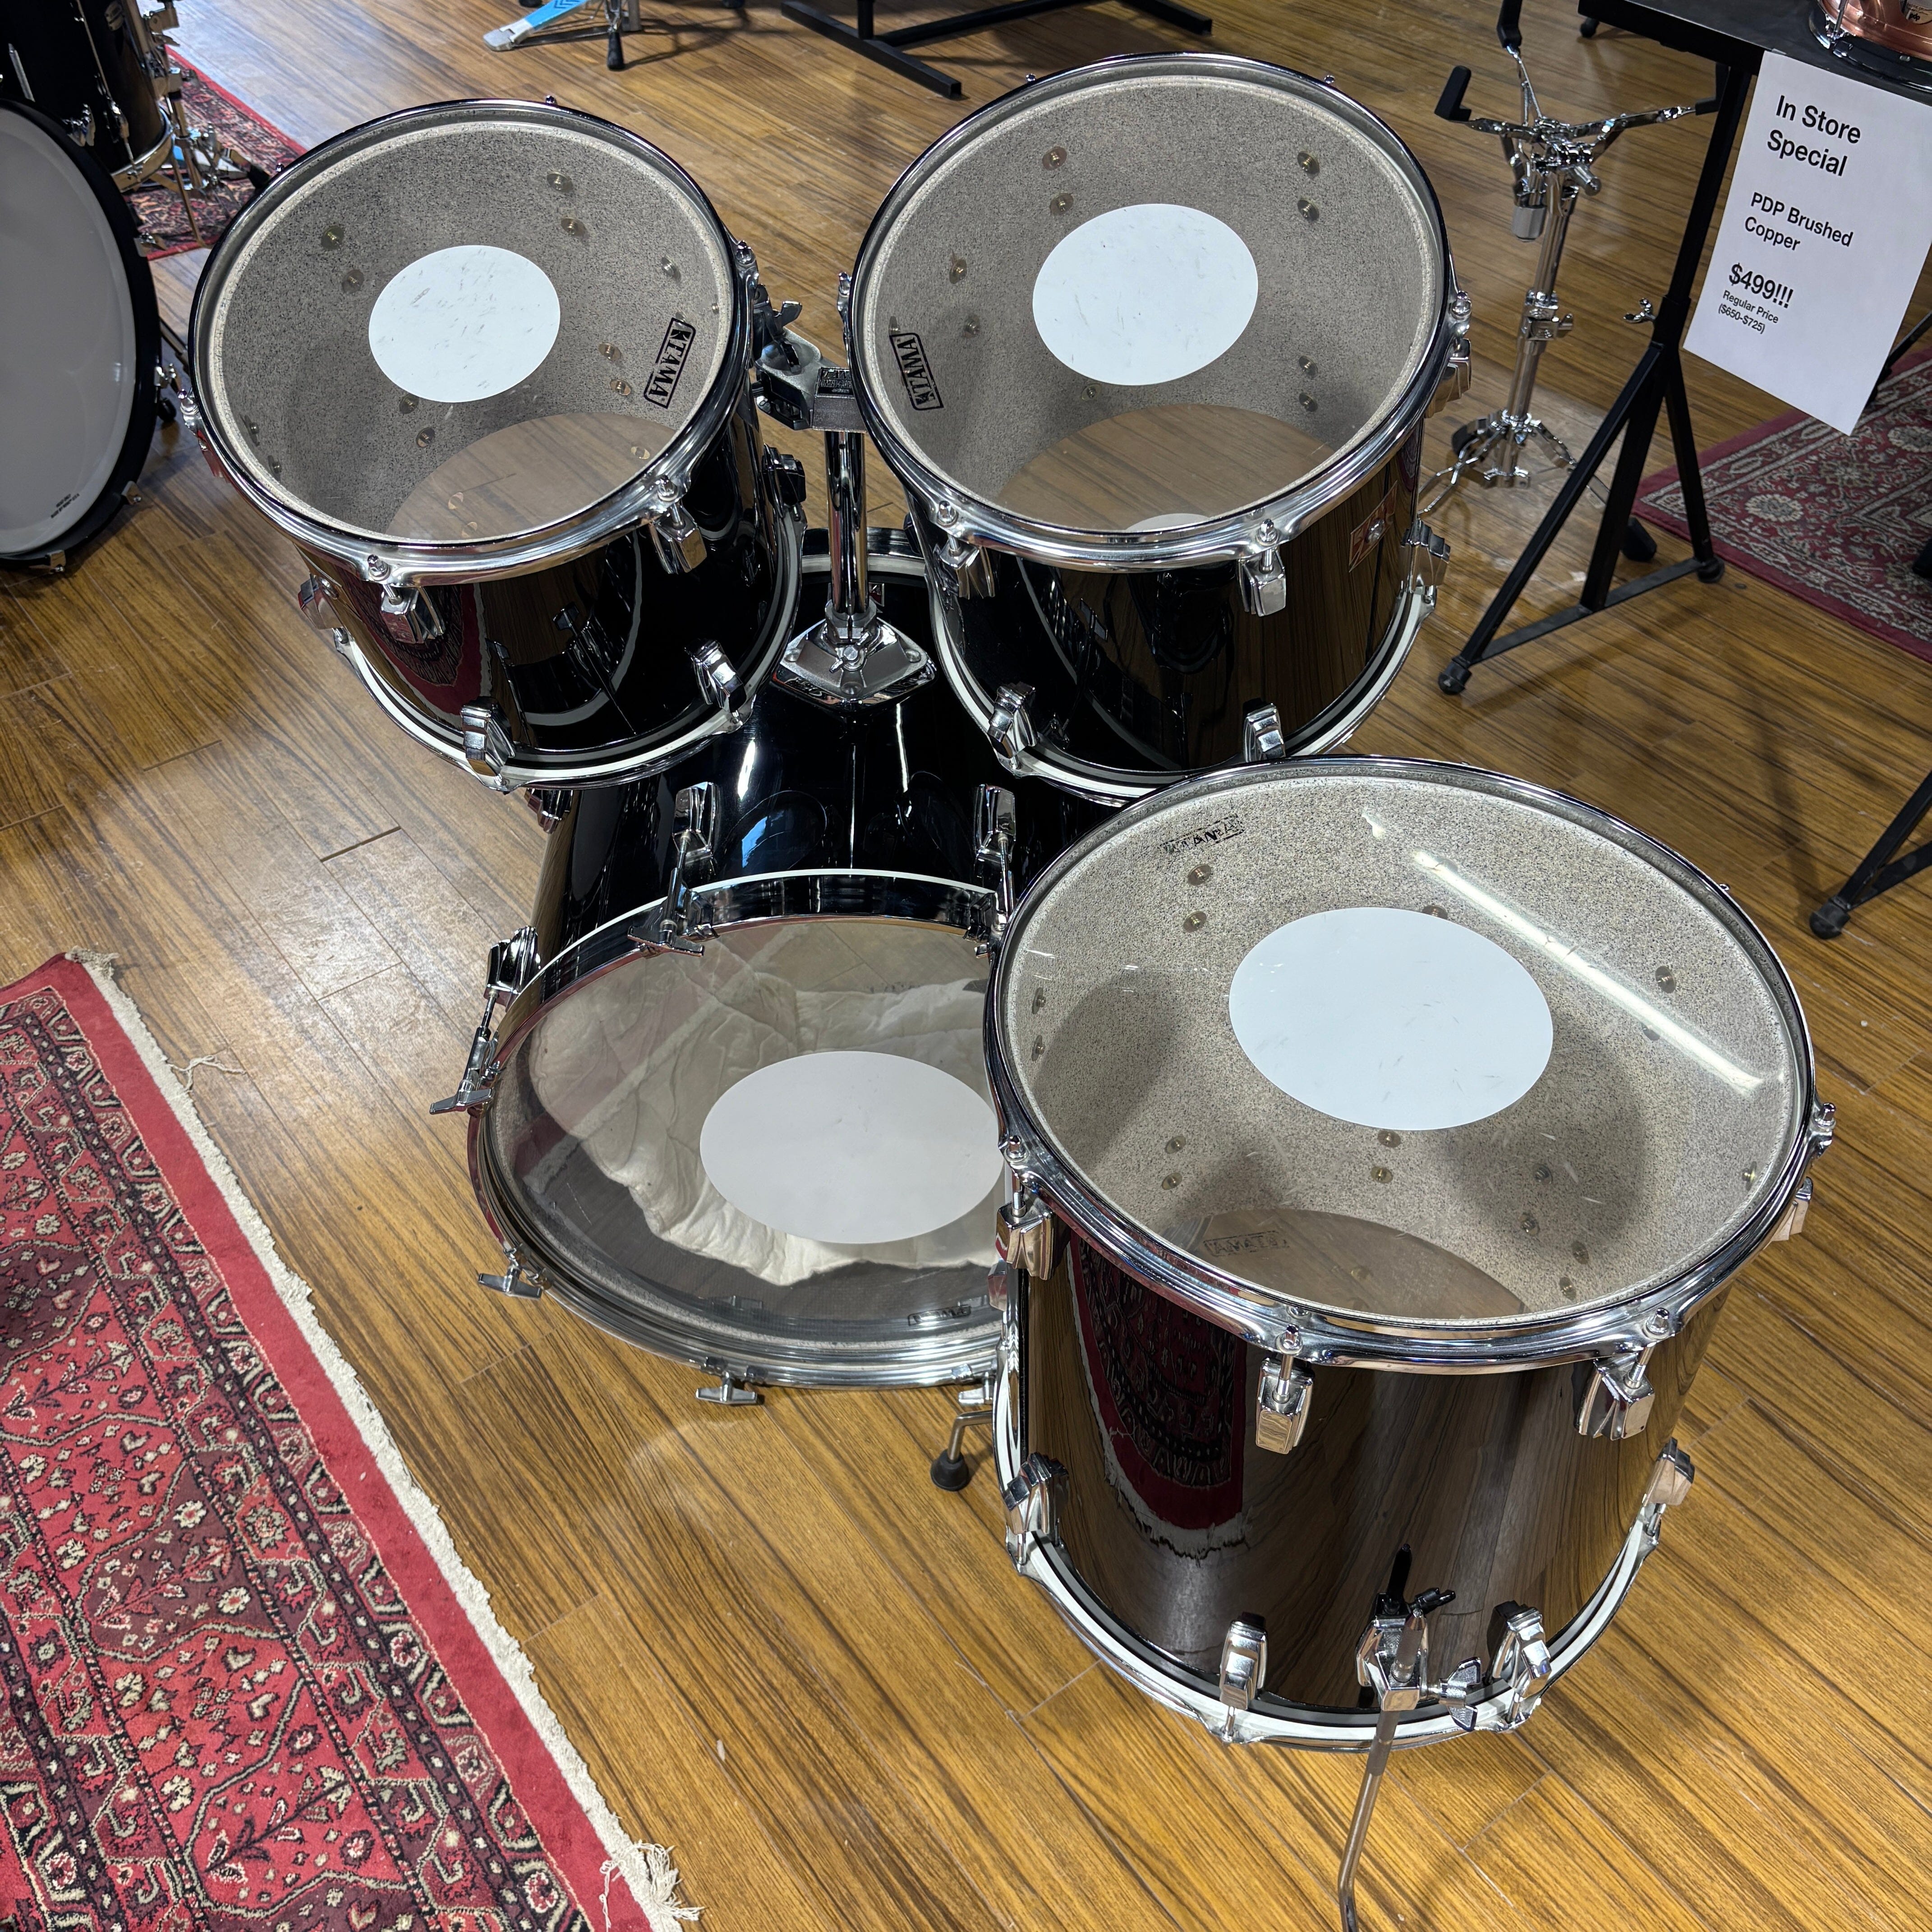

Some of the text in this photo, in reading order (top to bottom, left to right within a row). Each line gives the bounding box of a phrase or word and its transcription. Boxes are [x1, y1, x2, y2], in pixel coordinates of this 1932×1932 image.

[1909, 13, 1920, 21] pdp
[1776, 95, 1860, 143] In Store
[1767, 130, 1847, 176] Special
[1745, 216, 1800, 250] Copper
[1751, 192, 1854, 246] PDP Brushed
[1723, 290, 1779, 323] Regular Price
[1729, 262, 1794, 308] $499!!!
[1719, 304, 1765, 334] ($650-$725)
[649, 340, 686, 396] TAMA
[897, 337, 932, 394] TAMA
